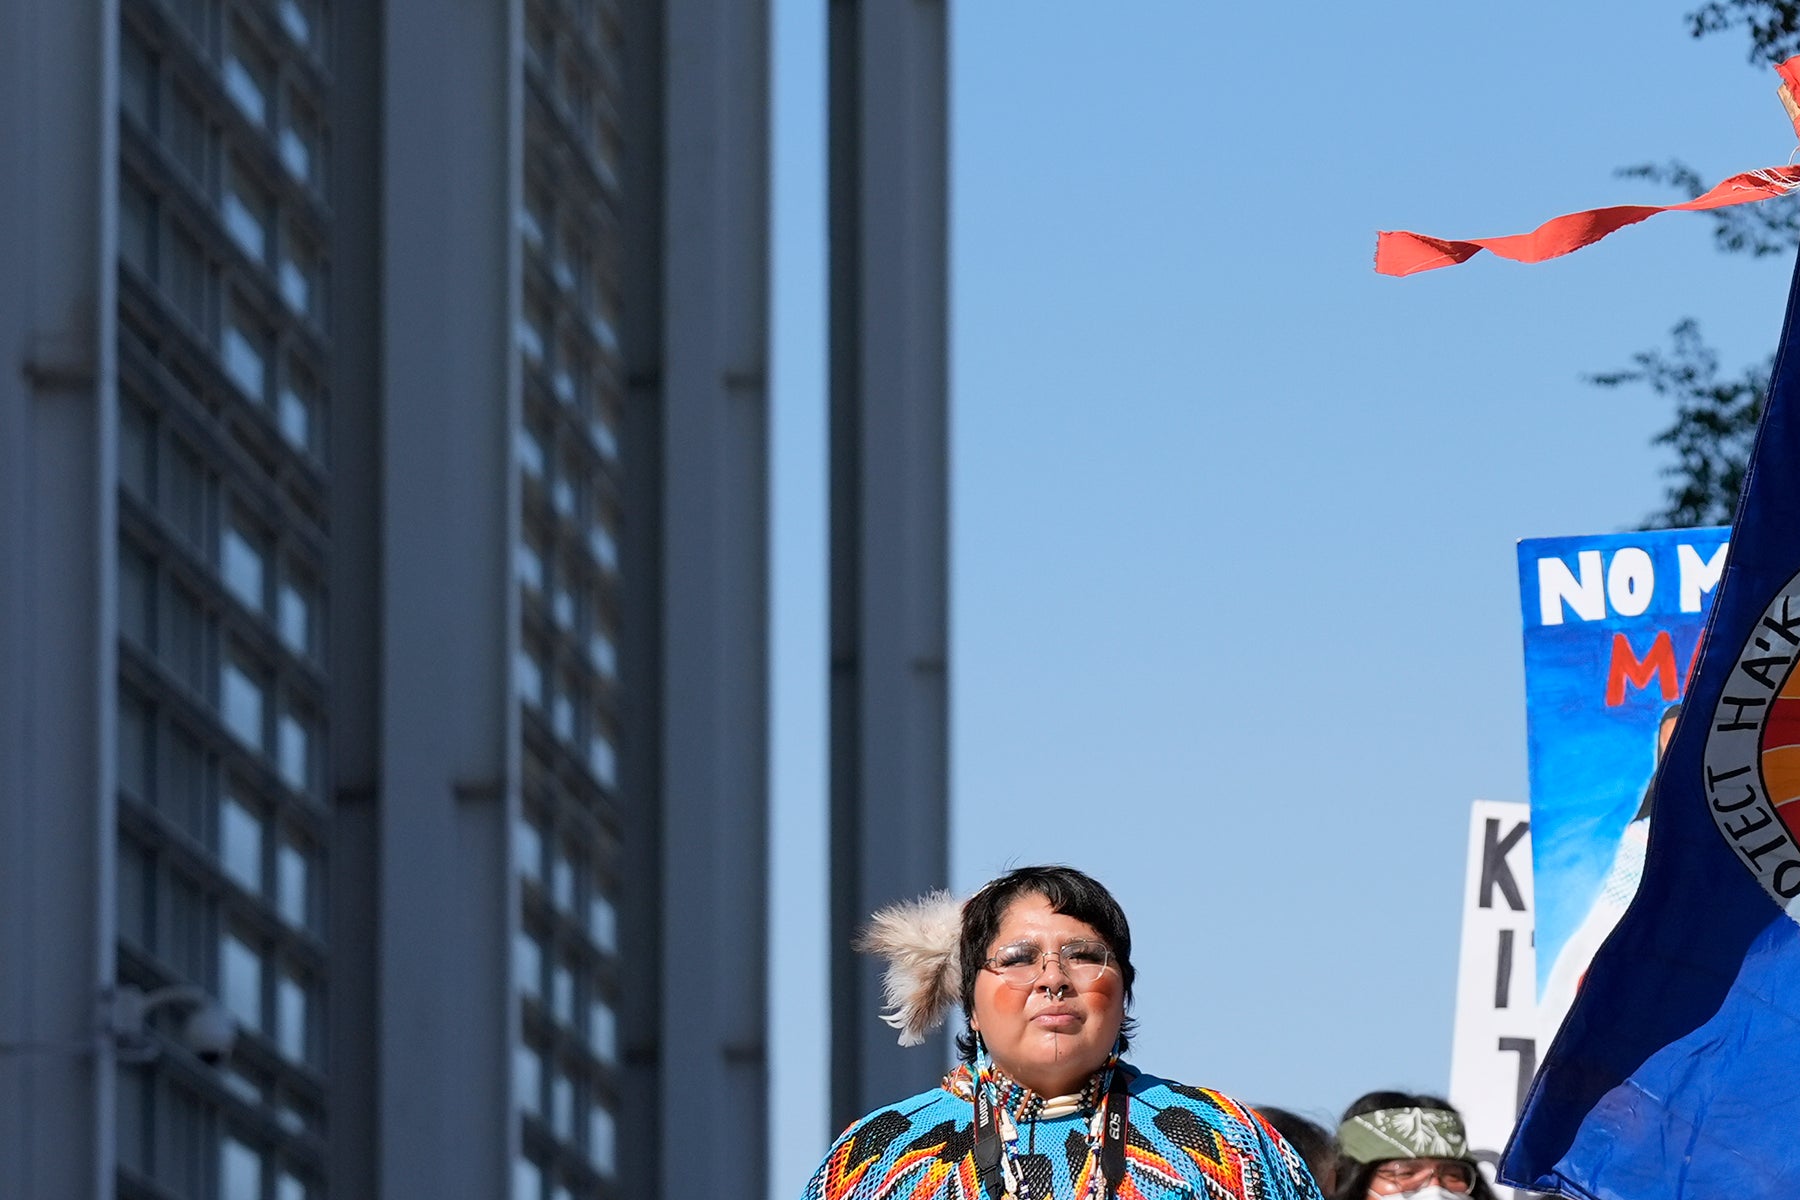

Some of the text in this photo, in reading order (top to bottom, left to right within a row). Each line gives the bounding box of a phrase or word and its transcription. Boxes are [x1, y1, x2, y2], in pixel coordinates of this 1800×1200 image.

[1537, 547, 1655, 626] NO
[978, 1090, 990, 1128] Canon
[1108, 1111, 1122, 1141] EOS
